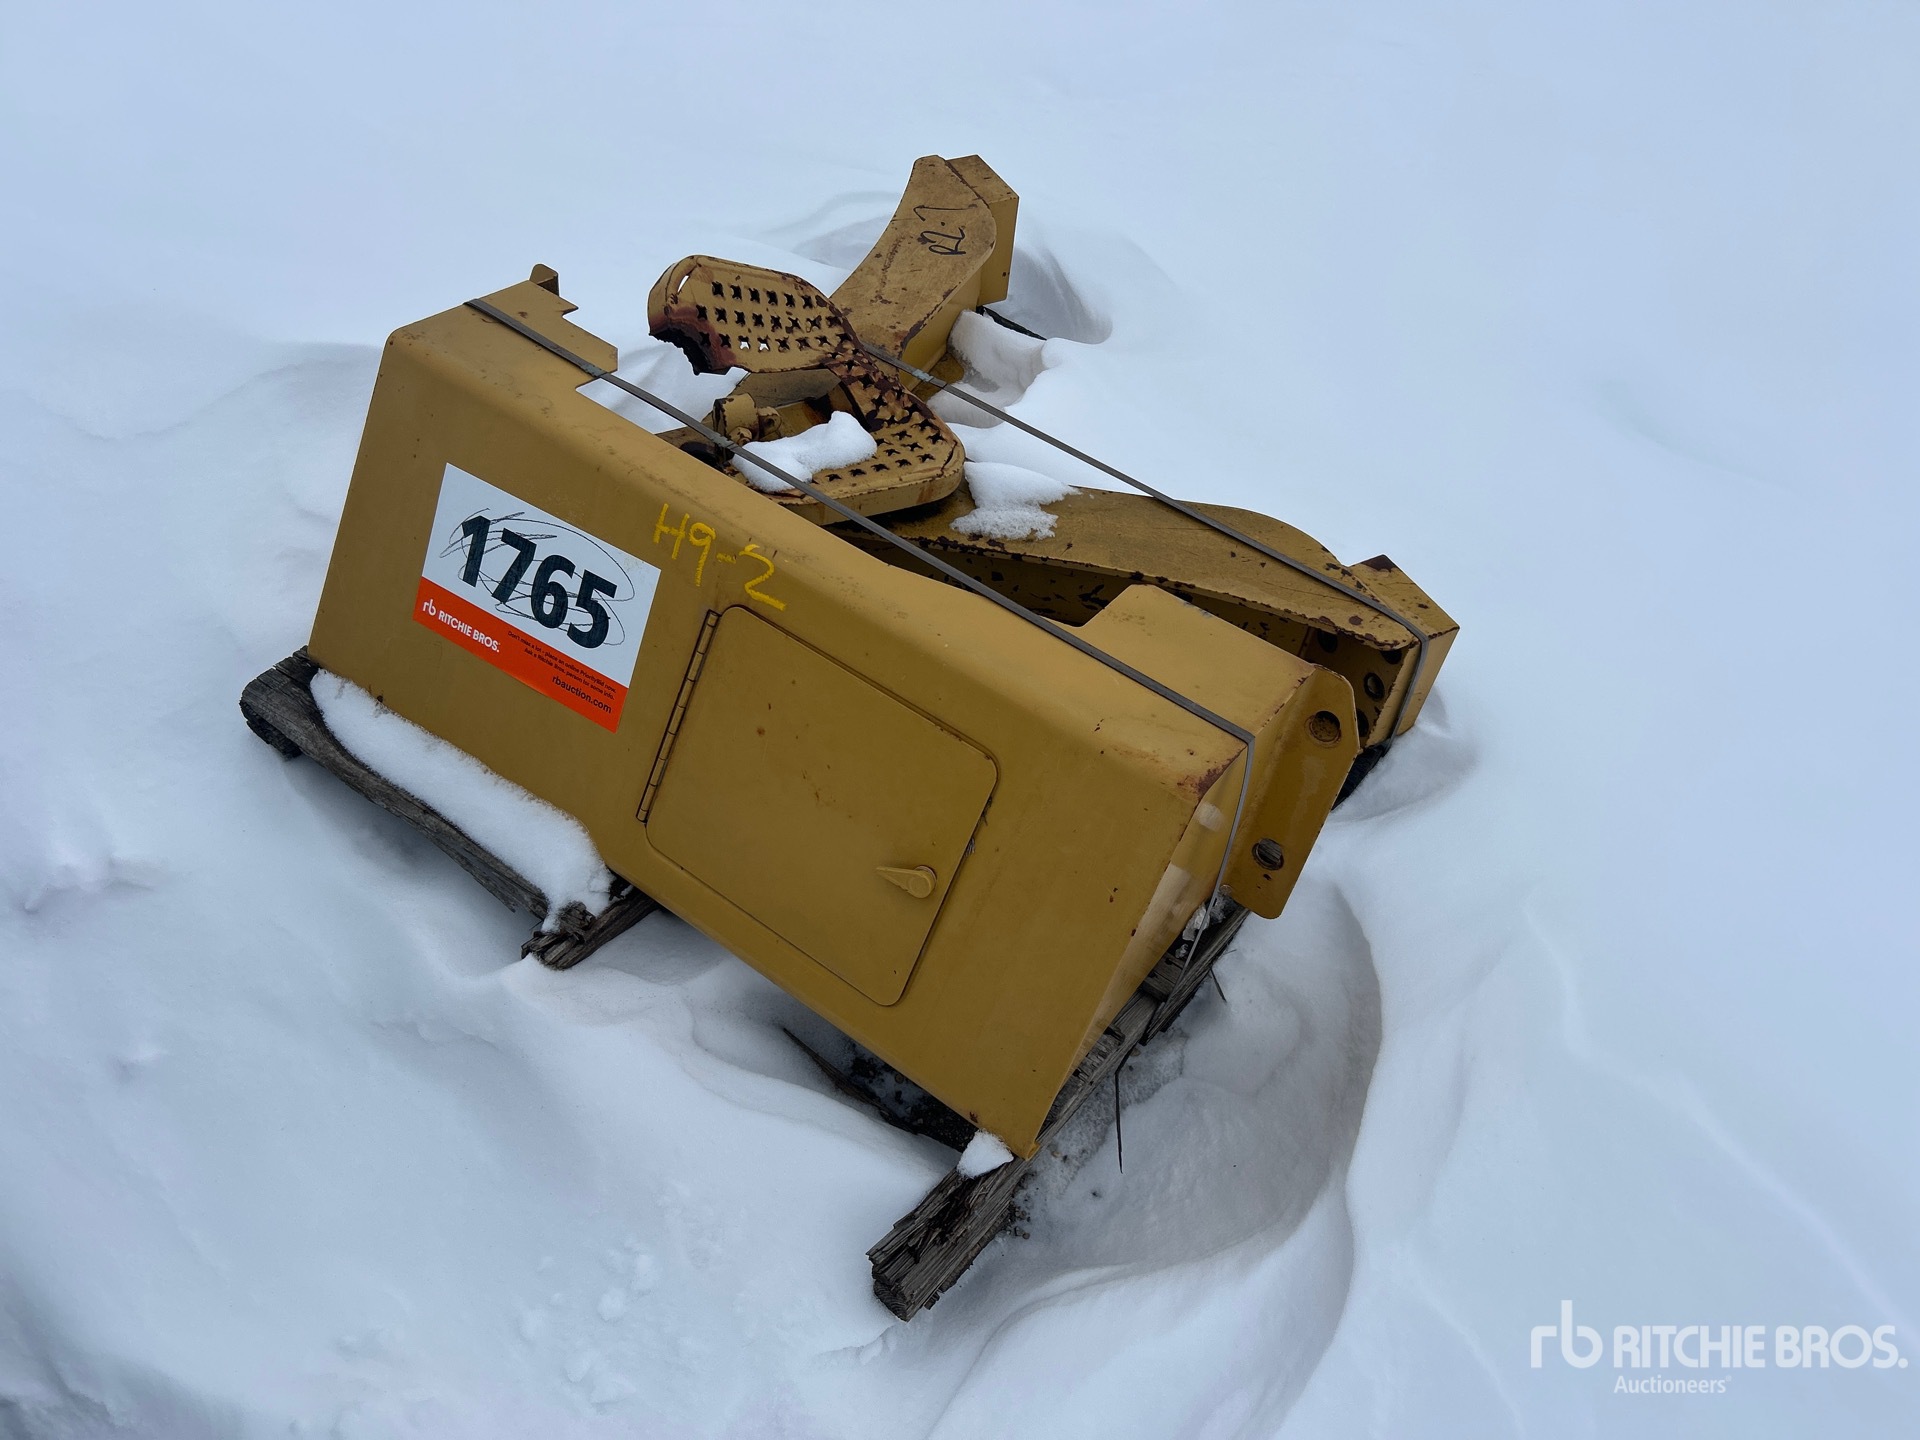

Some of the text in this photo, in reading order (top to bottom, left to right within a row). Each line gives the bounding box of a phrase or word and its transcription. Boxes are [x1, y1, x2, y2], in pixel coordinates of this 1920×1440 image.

[653, 503, 787, 611] H9-2
[461, 515, 618, 649] 1765
[422, 598, 436, 616] rb
[438, 610, 500, 653] RITCHIE BROS.
[552, 675, 612, 714] rbauction.com
